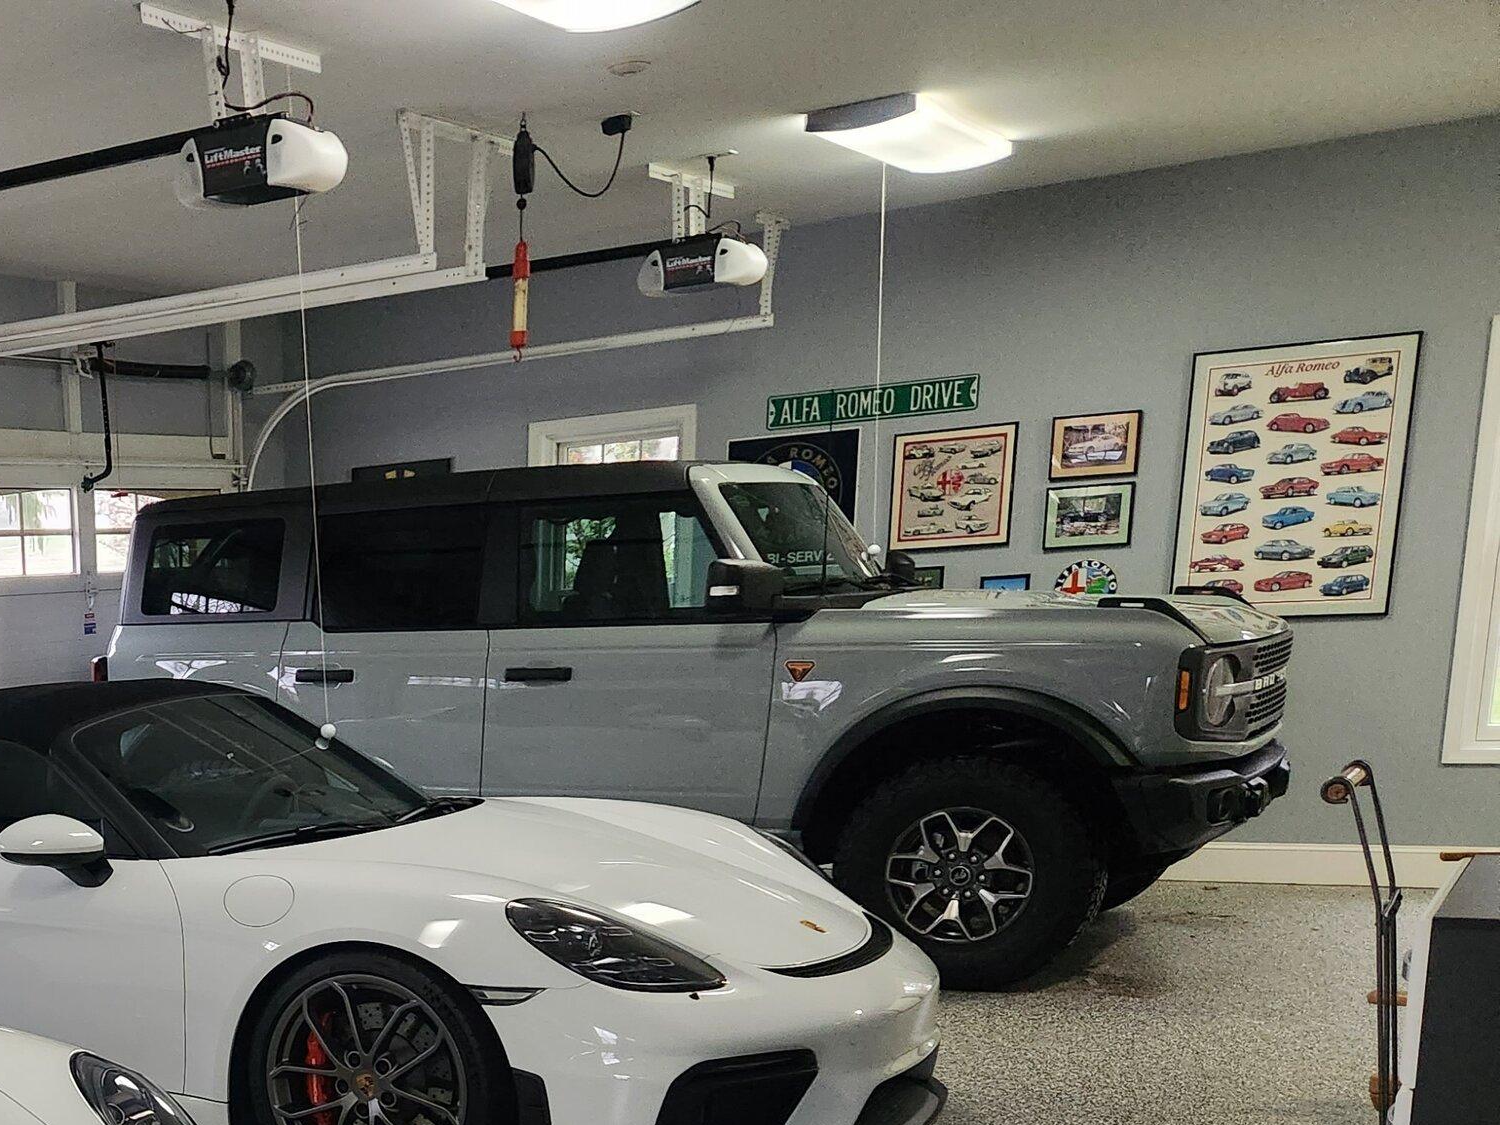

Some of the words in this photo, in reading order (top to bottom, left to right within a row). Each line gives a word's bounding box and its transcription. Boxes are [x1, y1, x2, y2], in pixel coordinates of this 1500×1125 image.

[204, 145, 262, 163] LiftMaster
[1265, 362, 1295, 377] Alfa
[1296, 360, 1341, 373] Romeo
[779, 398, 822, 424] ALFA
[835, 388, 895, 419] ROMEO
[910, 380, 966, 411] DRIVE
